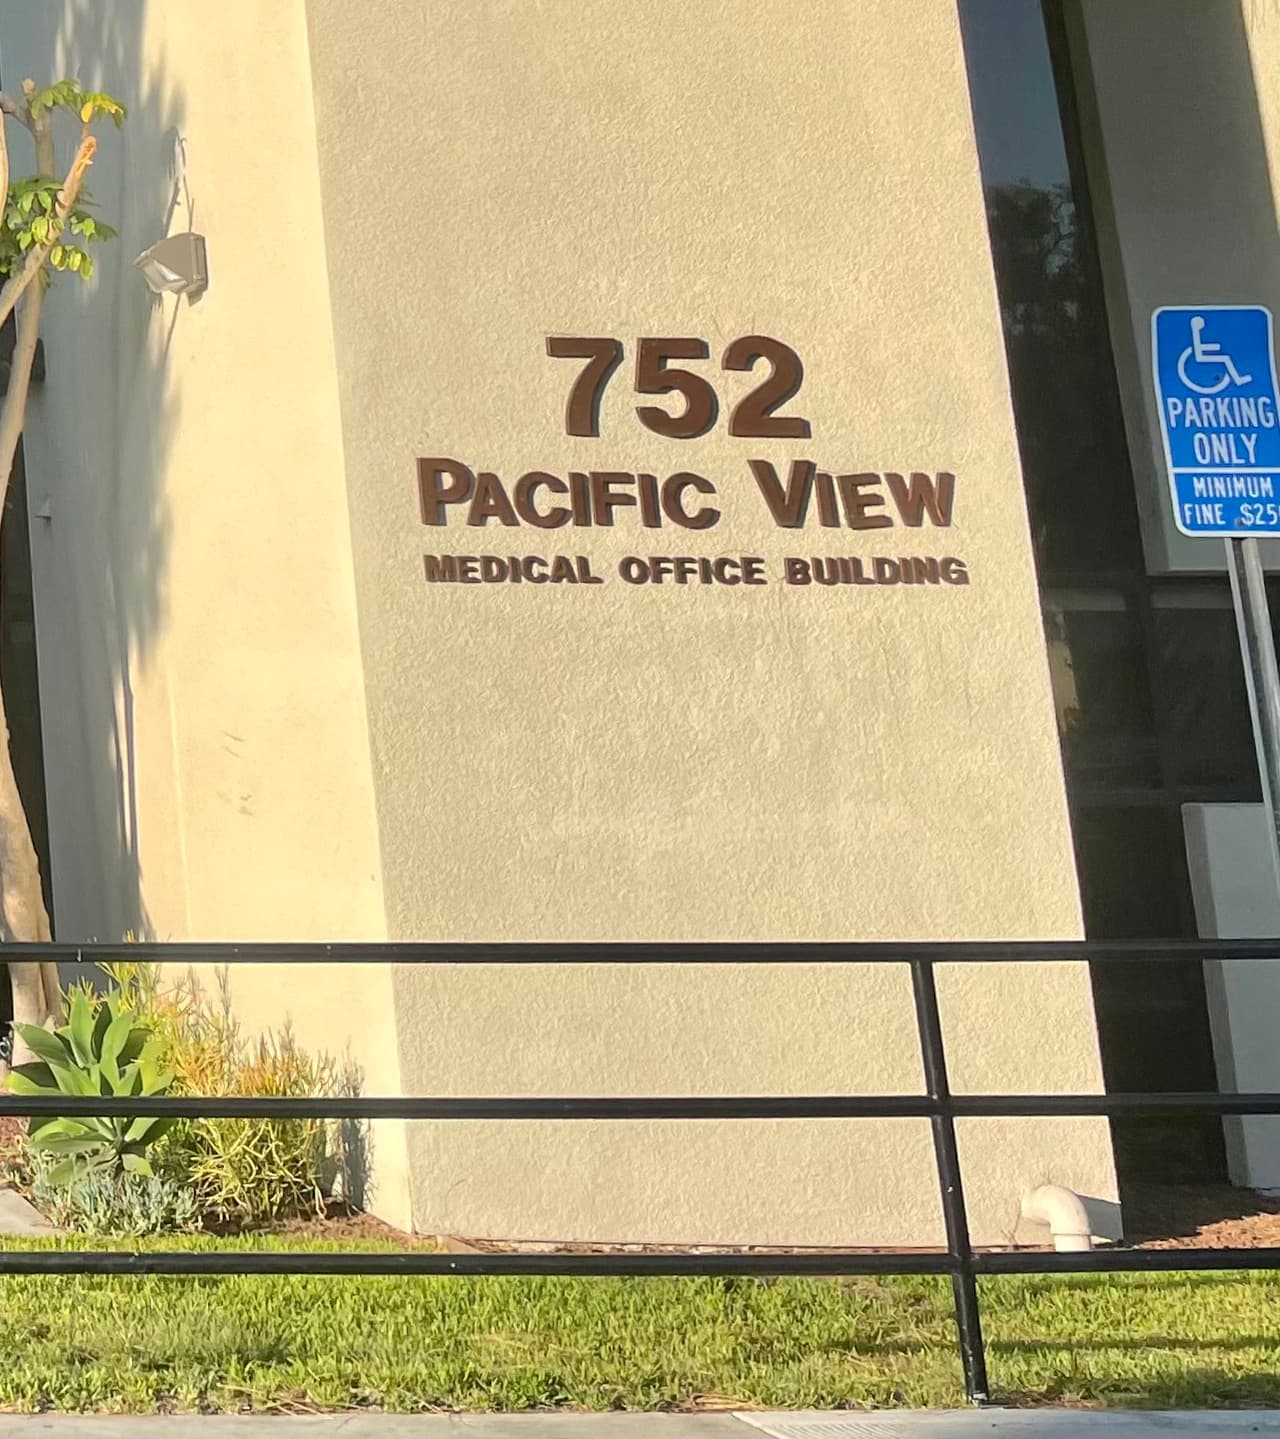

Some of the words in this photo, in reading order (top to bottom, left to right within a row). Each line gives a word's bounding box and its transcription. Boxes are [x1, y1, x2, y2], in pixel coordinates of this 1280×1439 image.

[545, 334, 812, 439] 752
[1167, 396, 1274, 429] PARKING
[1193, 432, 1258, 464] ONLY
[416, 456, 721, 530] PACIFIC
[746, 458, 957, 530] VIEW
[1192, 476, 1274, 499] MINIMUM
[1183, 503, 1227, 525] FINE
[1239, 503, 1280, 527] $25
[423, 553, 603, 585] MEDICAL
[618, 555, 767, 585] OFFICE
[784, 555, 970, 586] BUILDING
